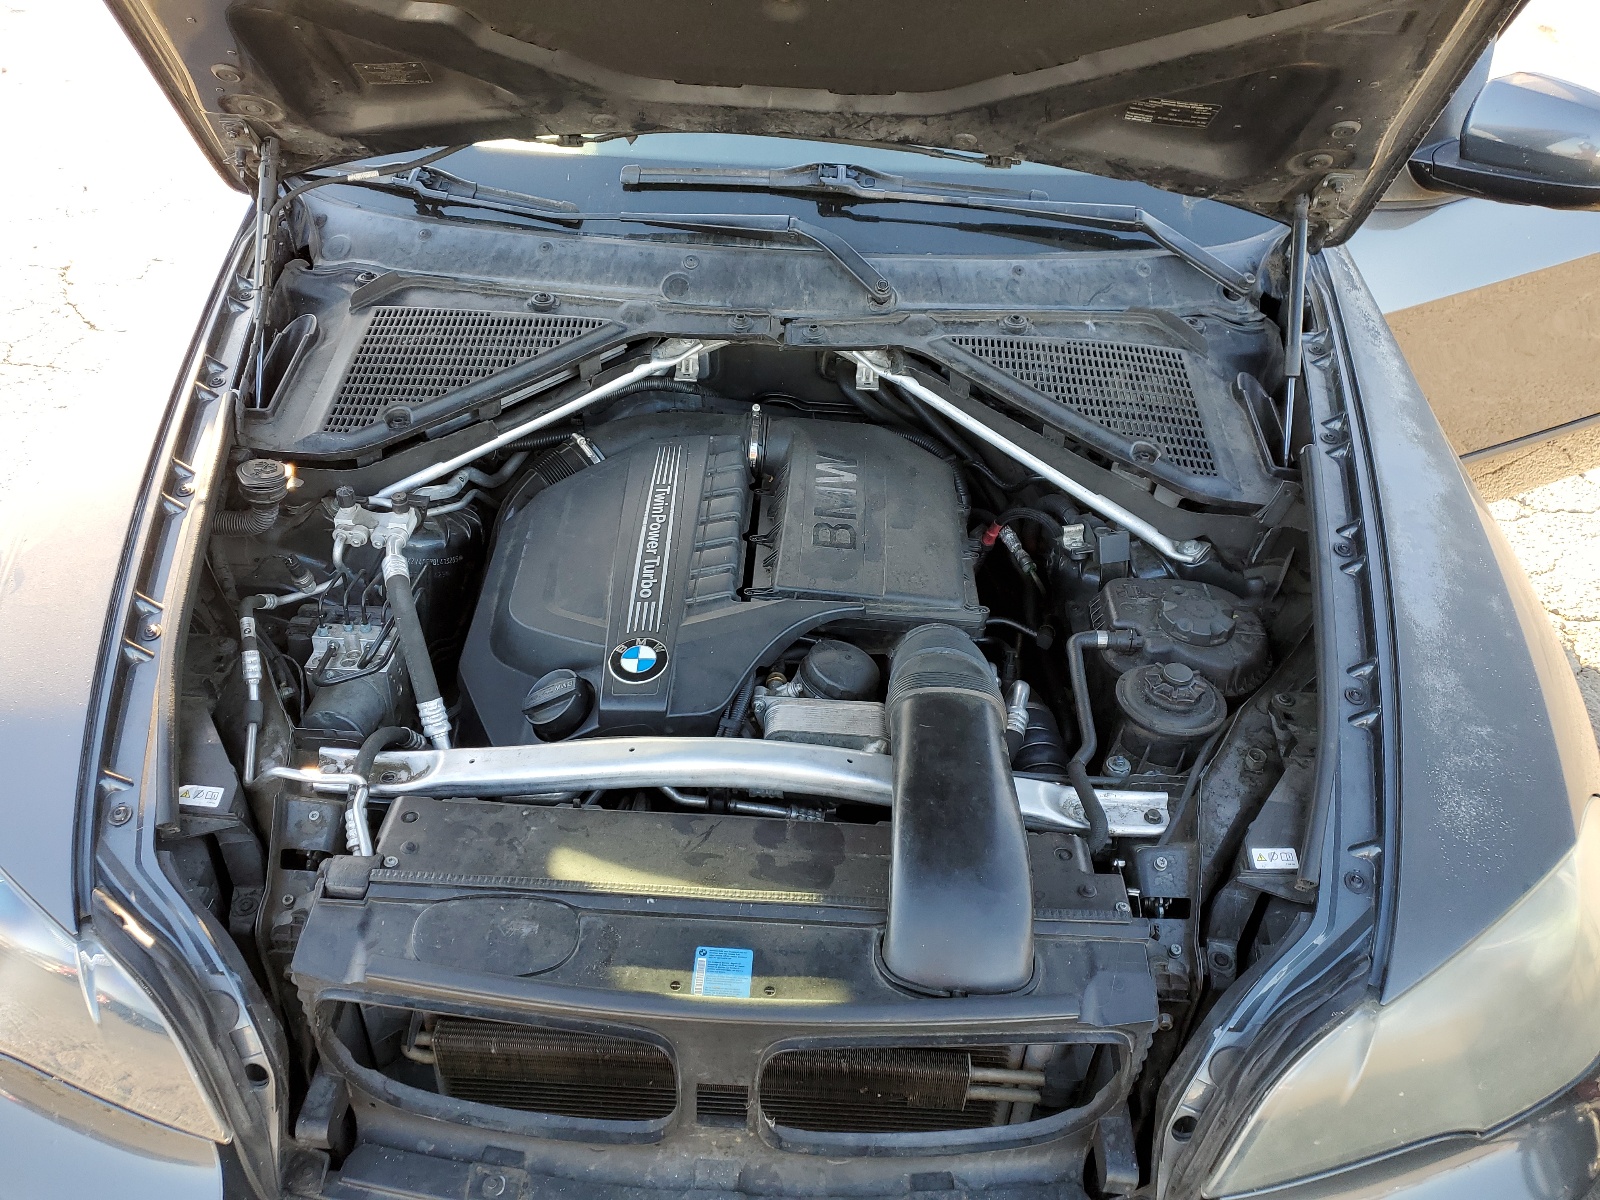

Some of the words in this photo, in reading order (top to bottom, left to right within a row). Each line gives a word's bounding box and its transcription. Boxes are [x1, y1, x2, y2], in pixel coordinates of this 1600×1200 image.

[645, 485, 671, 554] TwinPower
[813, 451, 858, 549] BMW
[639, 557, 661, 598] Turbo
[616, 638, 665, 653] BMW
